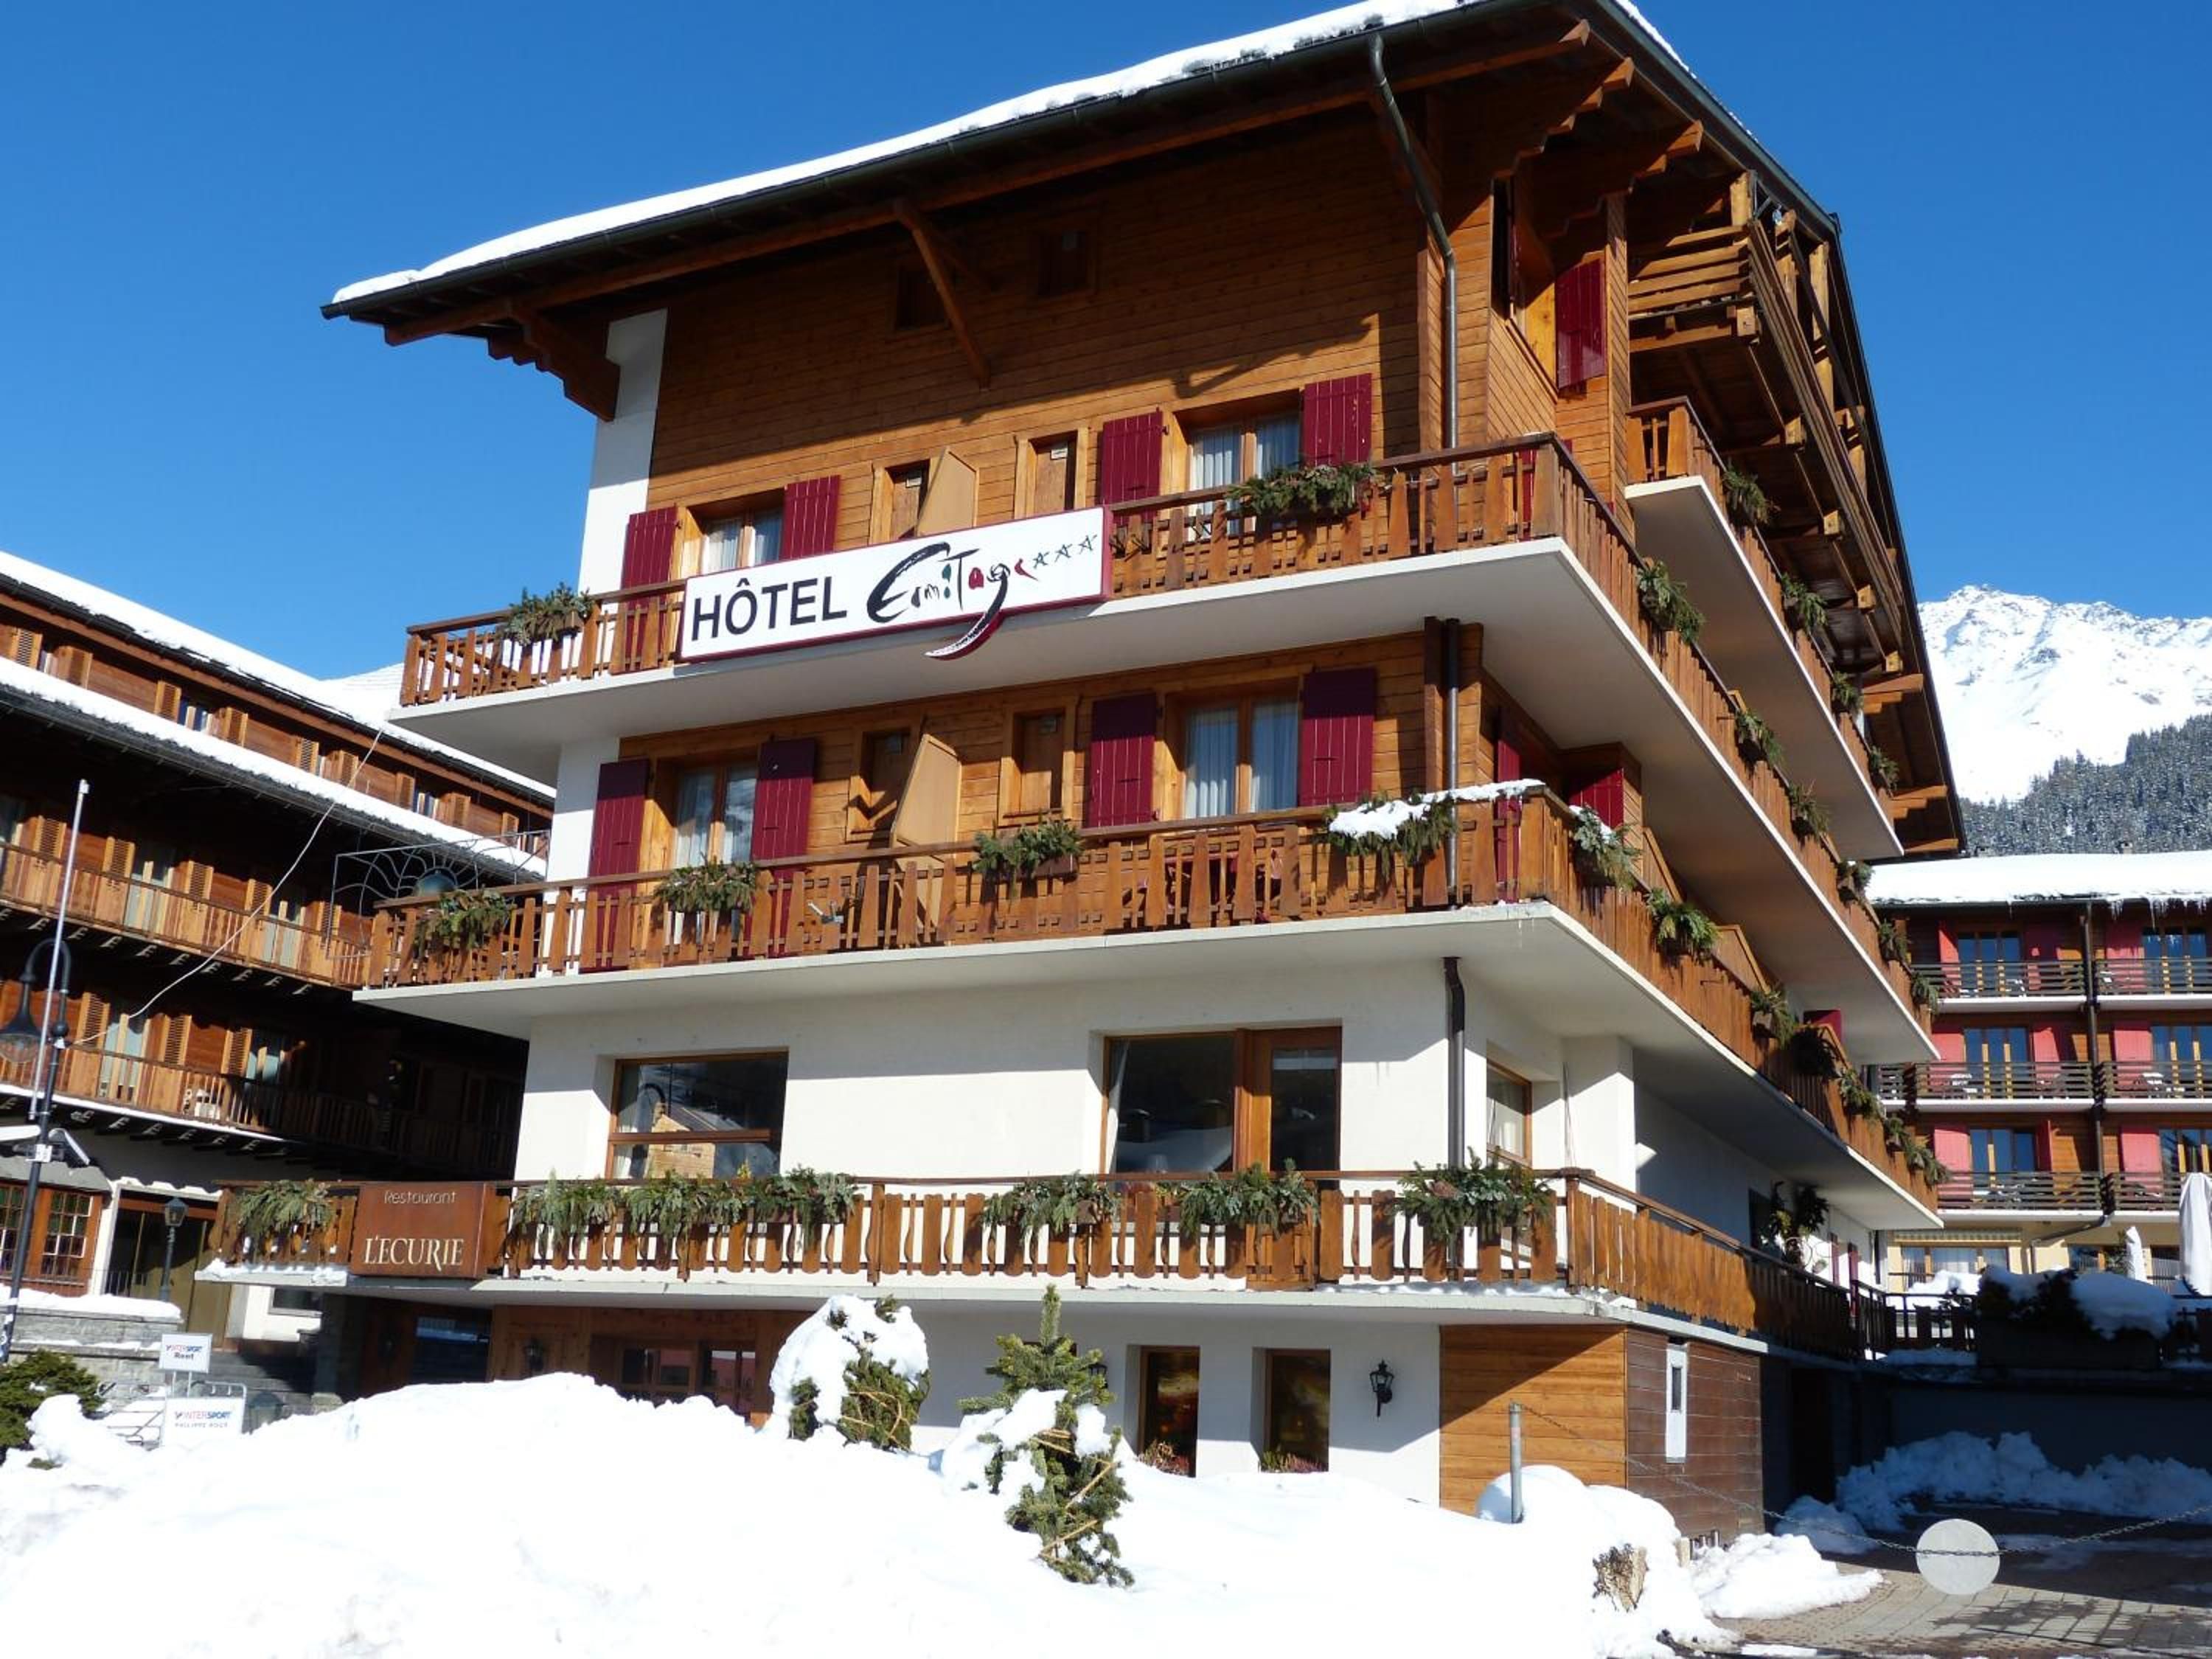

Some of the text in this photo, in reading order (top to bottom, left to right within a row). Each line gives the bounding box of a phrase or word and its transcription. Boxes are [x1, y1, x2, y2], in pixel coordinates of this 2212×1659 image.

[692, 577, 847, 641] HÔTEL
[383, 1190, 456, 1204] Restaurant
[364, 1234, 465, 1272] L'ECURIE
